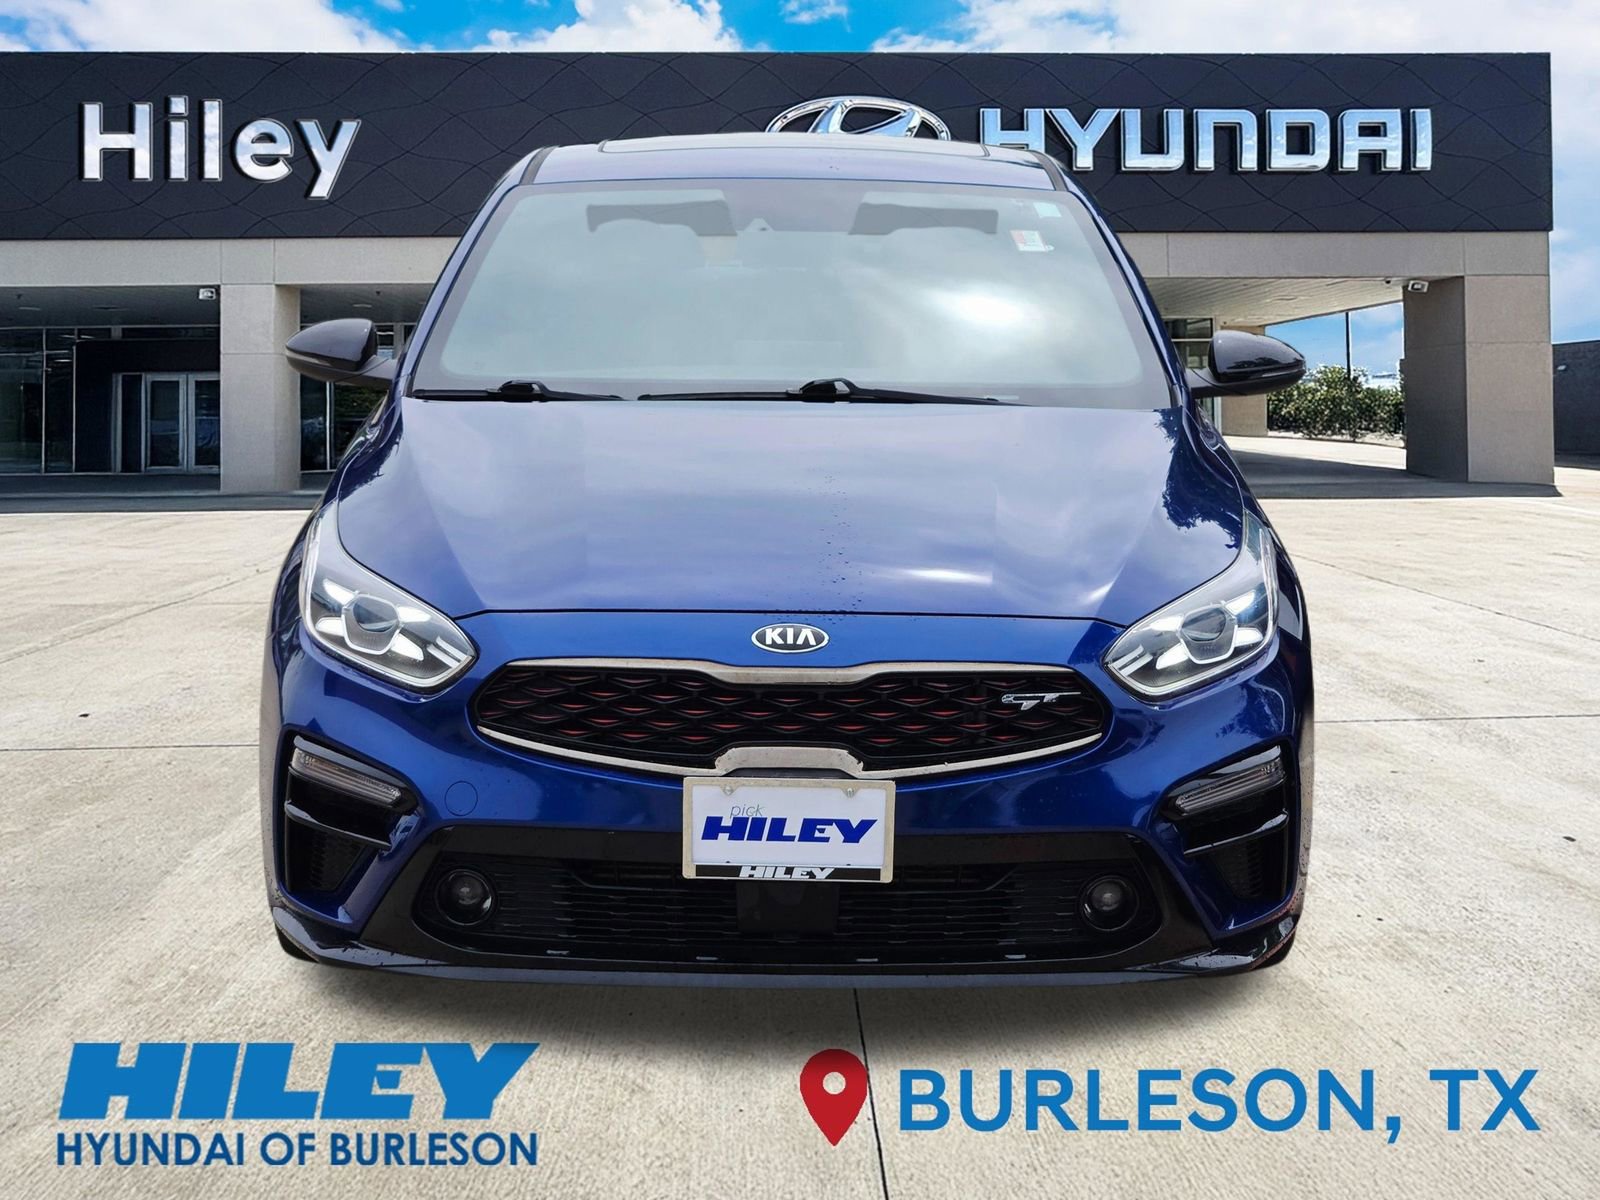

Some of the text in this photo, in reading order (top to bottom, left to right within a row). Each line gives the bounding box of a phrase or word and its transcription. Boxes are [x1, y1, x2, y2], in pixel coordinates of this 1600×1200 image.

[80, 95, 361, 200] Hiley
[980, 107, 1433, 173] HYUNDAI
[764, 627, 817, 646] KIA
[730, 803, 764, 819] pick
[701, 816, 878, 844] HILEY
[738, 865, 836, 880] HILEY
